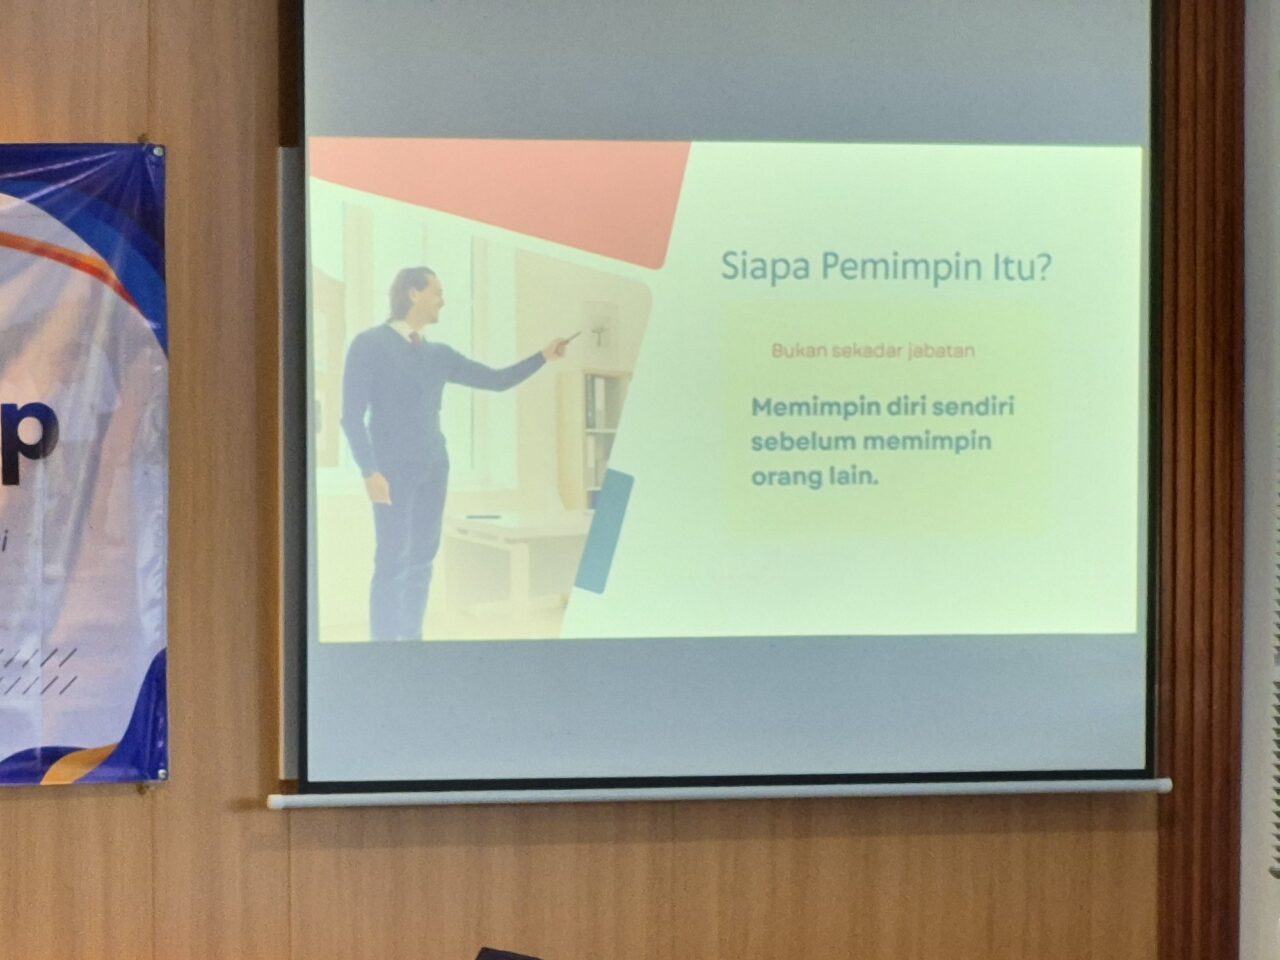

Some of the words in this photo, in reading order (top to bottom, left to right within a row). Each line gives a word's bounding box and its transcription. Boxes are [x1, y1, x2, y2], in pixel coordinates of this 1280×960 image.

[722, 250, 809, 287] Siapa
[823, 251, 981, 288] Pemimpin
[994, 253, 1051, 281] Itu?
[771, 342, 827, 358] Bukan
[832, 343, 903, 358] sekadar
[908, 342, 975, 361] jabatan
[752, 395, 881, 421] Memimpin
[887, 395, 926, 416] diri
[932, 395, 1014, 416] sendiri
[752, 431, 856, 451] sebelum
[863, 429, 991, 454] memimpin
[752, 470, 822, 490] orang
[830, 464, 878, 485] lain.
